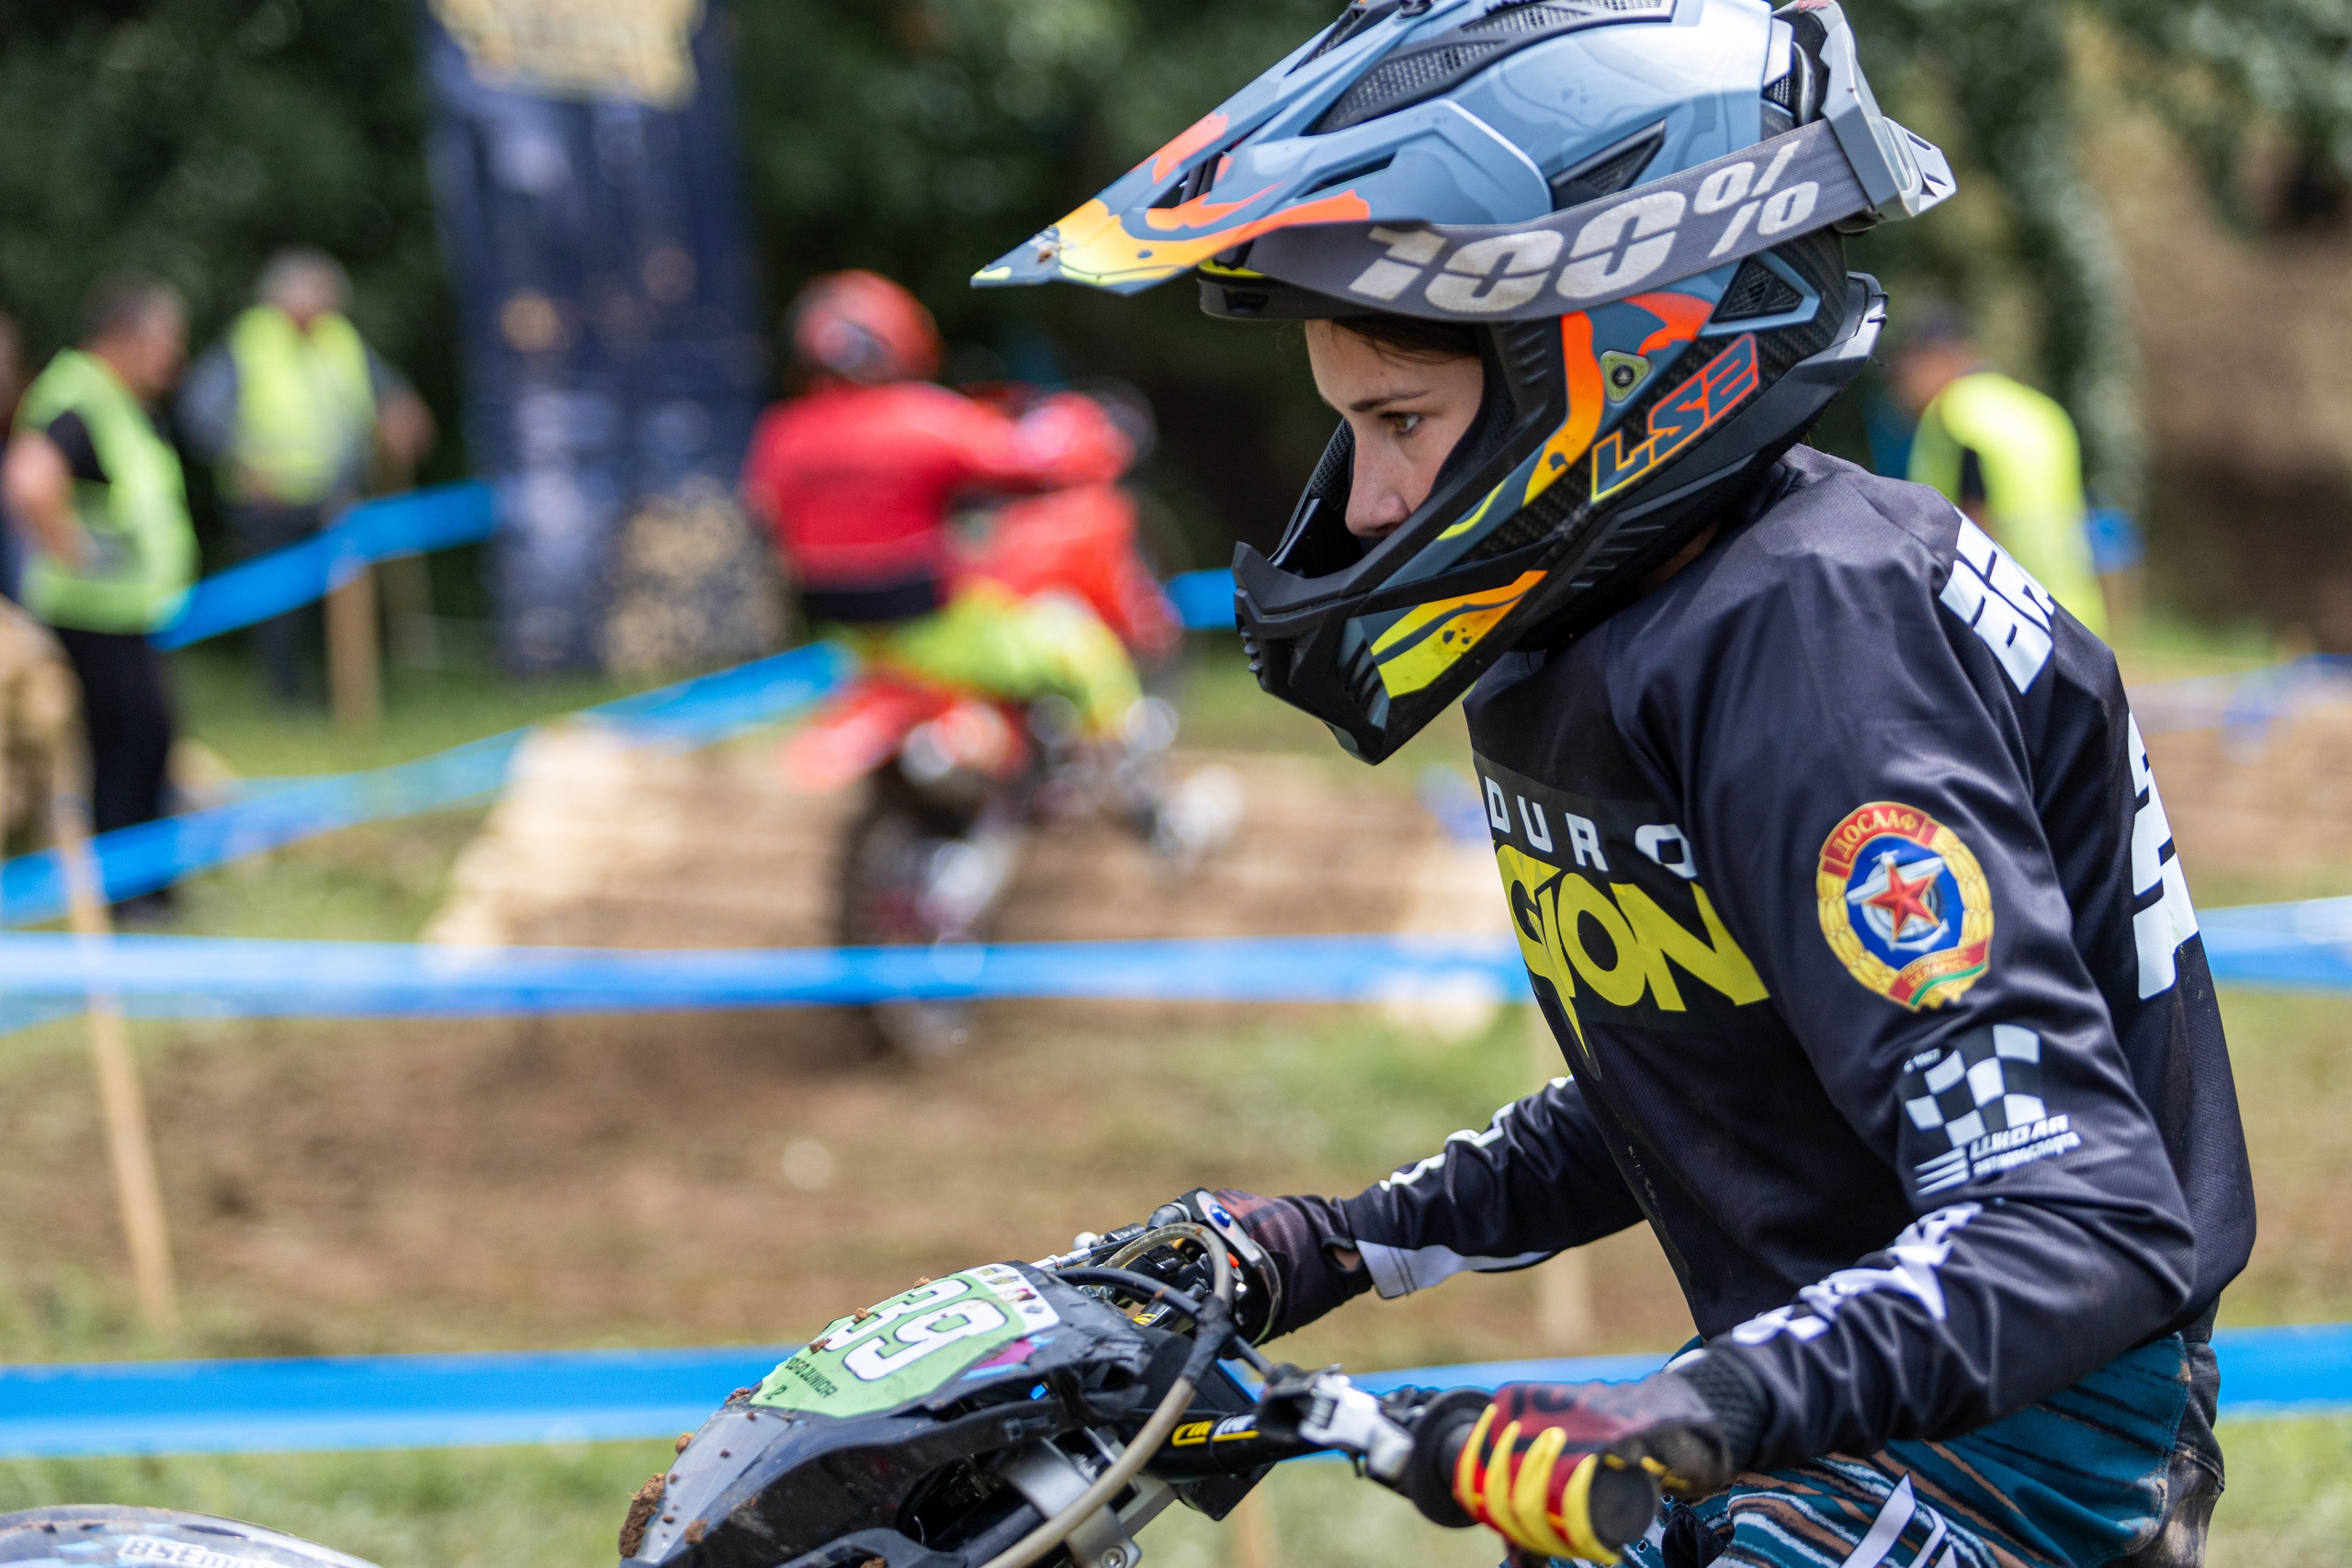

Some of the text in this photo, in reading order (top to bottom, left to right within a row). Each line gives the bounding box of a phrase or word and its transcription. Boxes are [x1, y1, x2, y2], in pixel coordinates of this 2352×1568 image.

[1348, 139, 1819, 313] 100%
[1590, 333, 1759, 503] LS2
[1831, 808, 1919, 860] ДОСААФ
[1493, 839, 1770, 1047] GION
[1969, 1114, 2069, 1162] ШКОЛА
[823, 1278, 1009, 1382] 39
